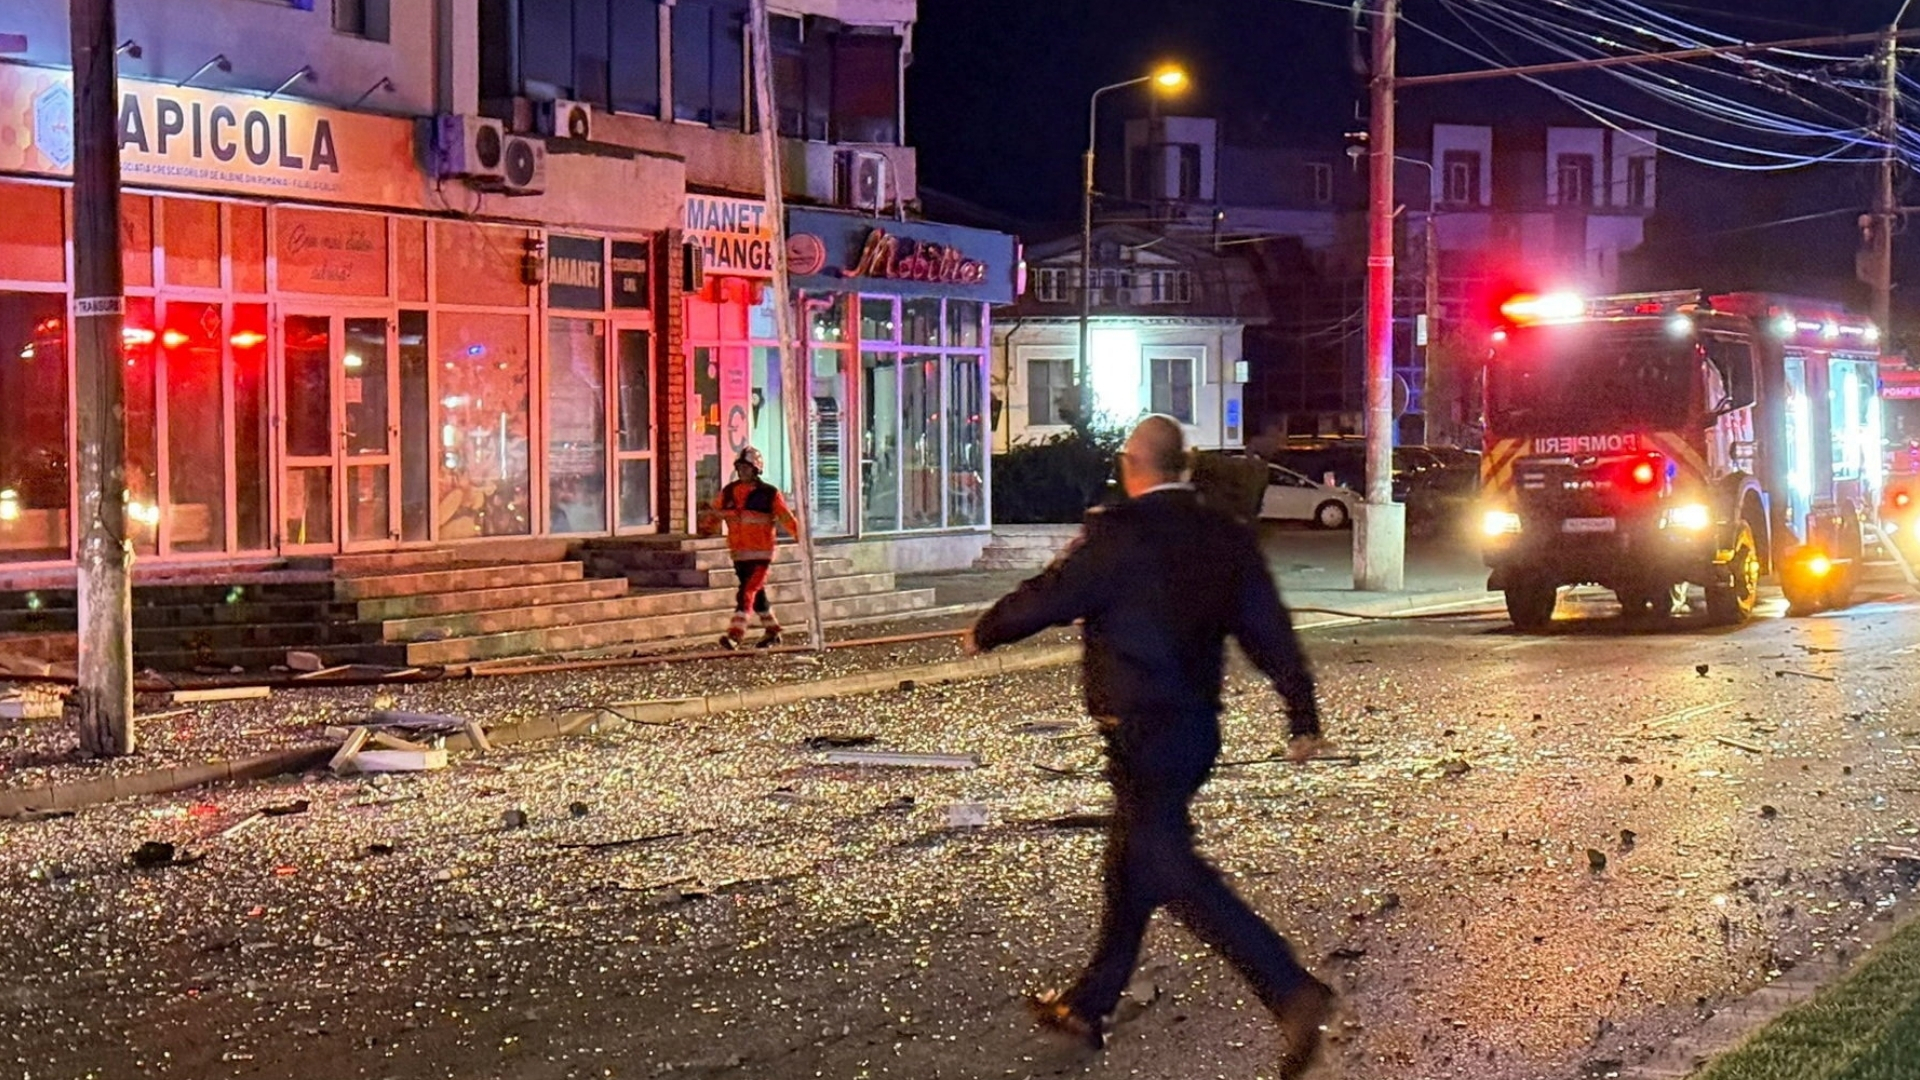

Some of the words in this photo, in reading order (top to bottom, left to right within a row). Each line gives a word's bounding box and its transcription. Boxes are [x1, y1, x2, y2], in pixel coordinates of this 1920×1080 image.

[119, 93, 339, 173] APICOLA
[687, 234, 774, 271] HANGE
[549, 256, 601, 289] AMANET
